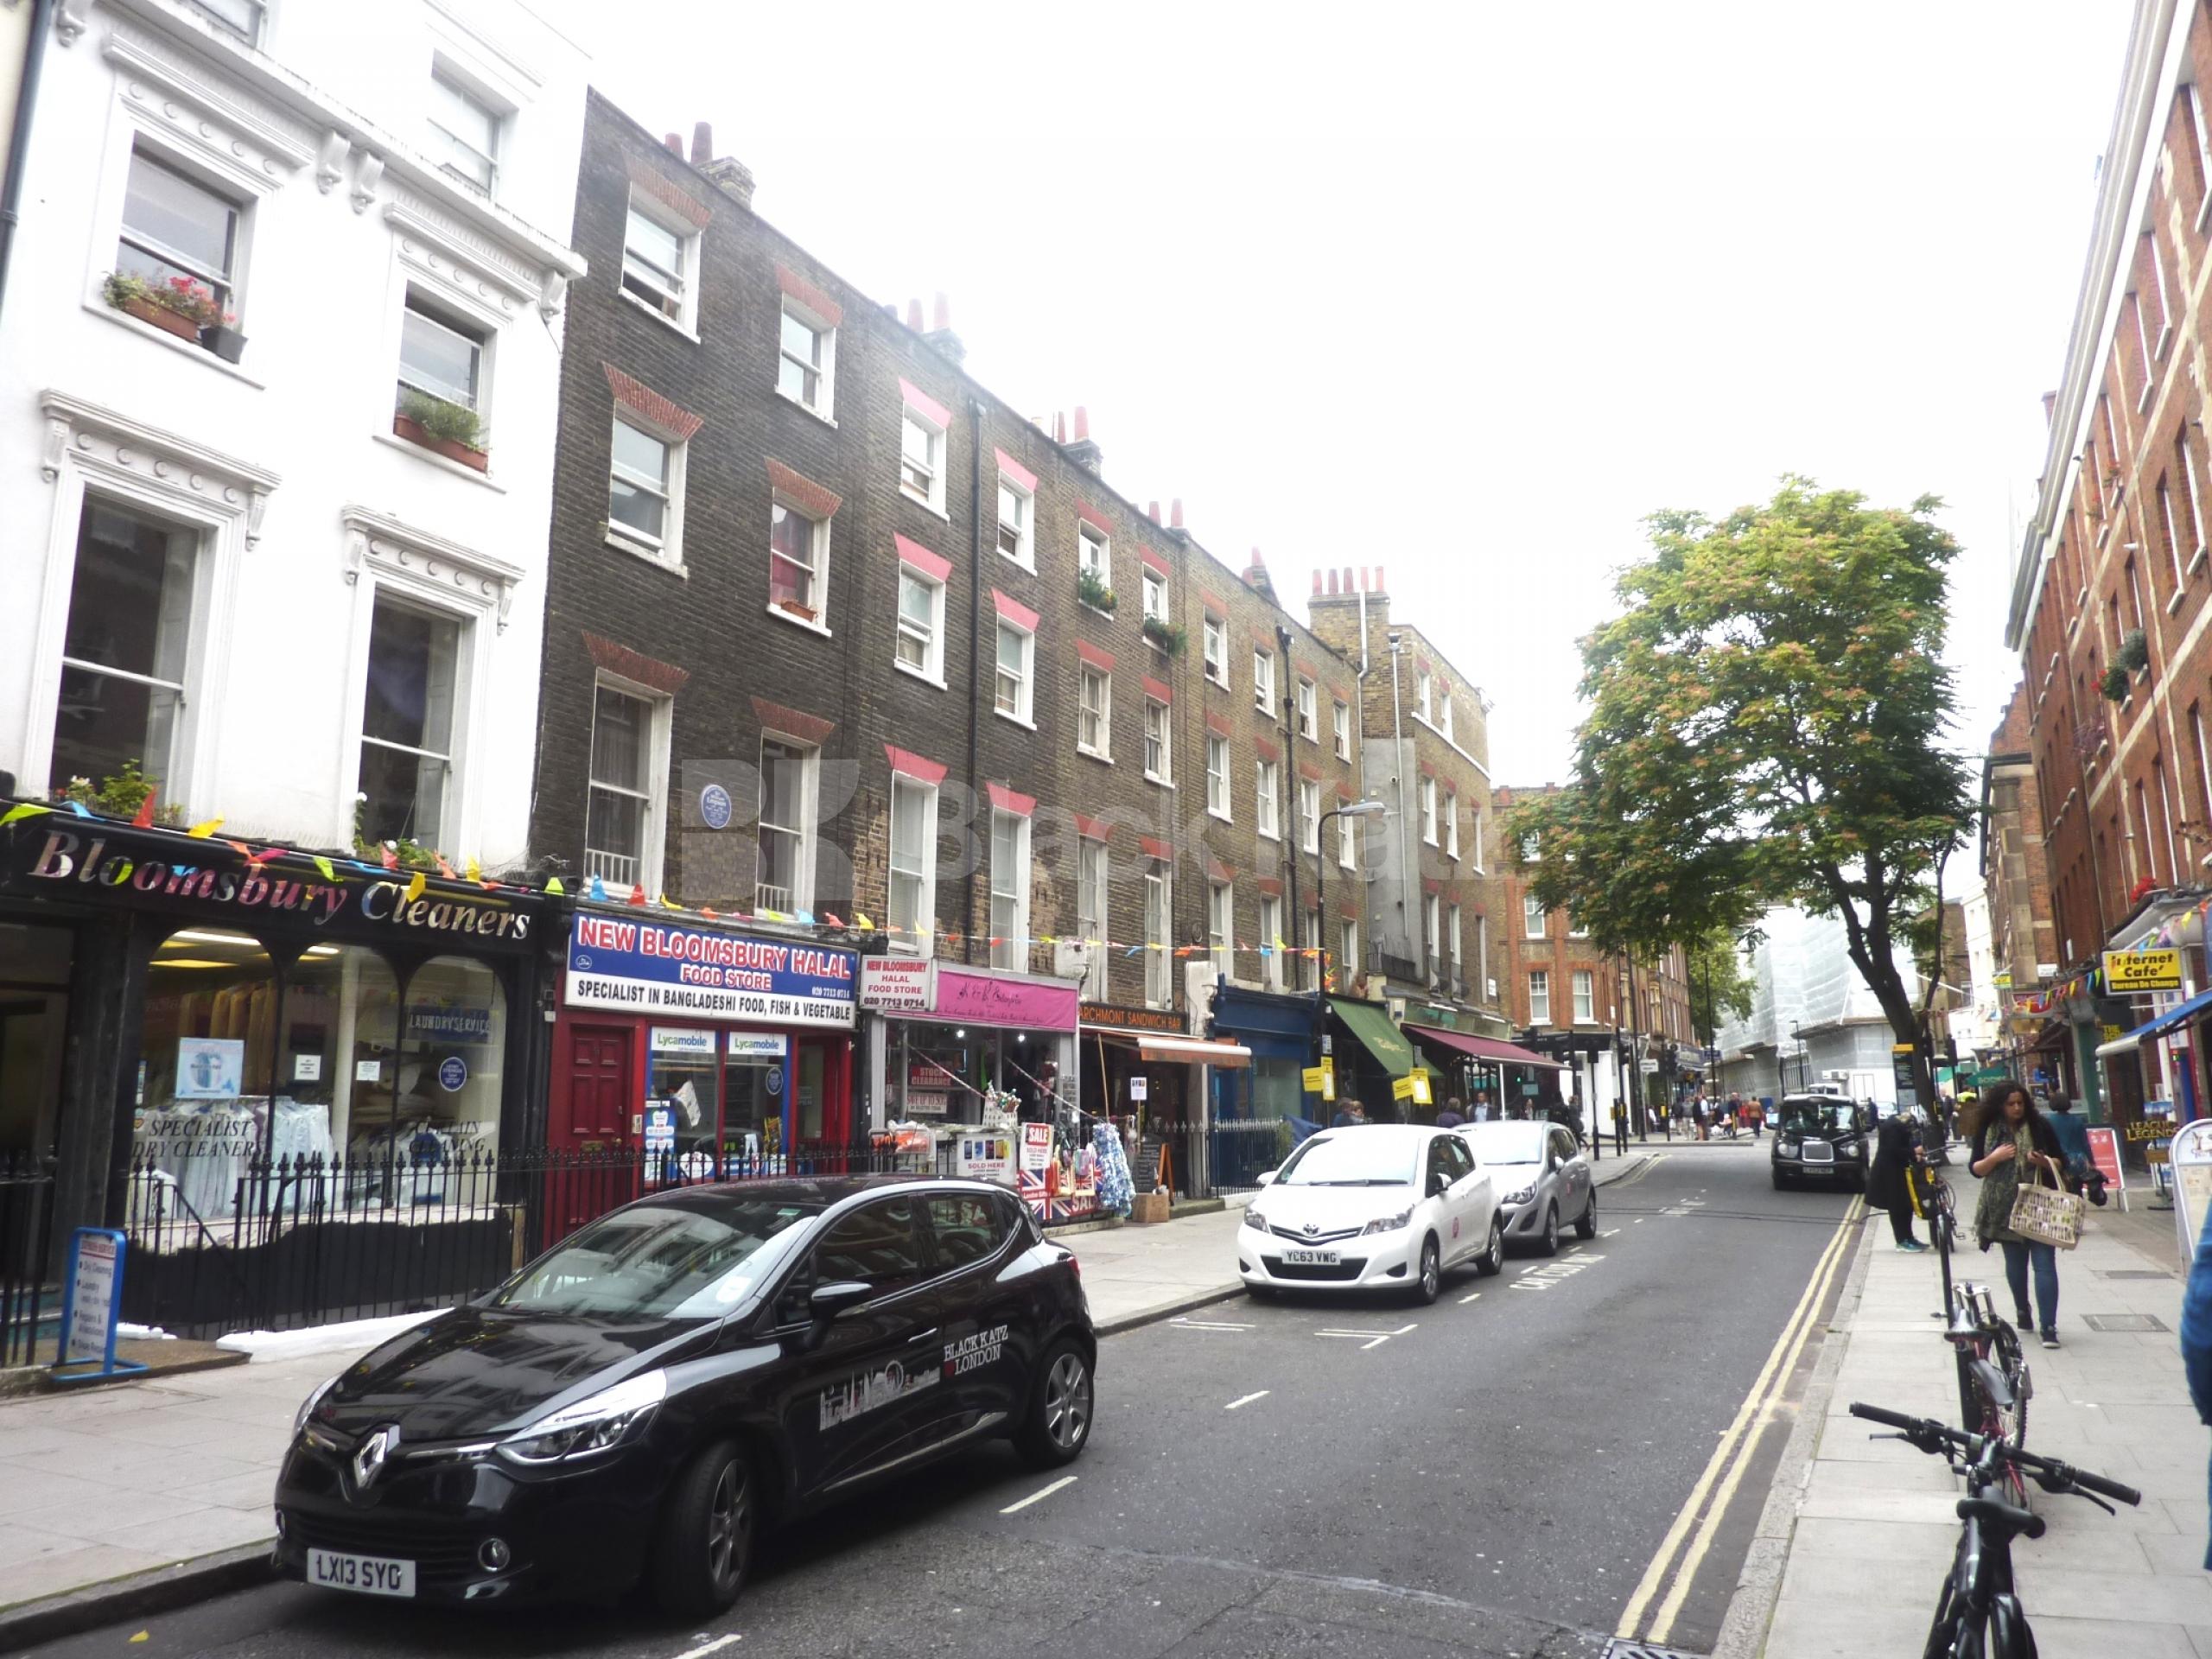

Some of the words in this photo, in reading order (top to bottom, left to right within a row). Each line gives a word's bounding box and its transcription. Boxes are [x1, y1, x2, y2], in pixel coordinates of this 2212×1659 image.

[28, 830, 347, 926] Bloomsbury
[361, 880, 531, 940] Cleaners
[578, 916, 636, 951] NEW
[640, 926, 789, 972] BLOOMSBURY
[791, 948, 851, 979] HALAL
[867, 961, 882, 971] NEW
[883, 961, 927, 973] BLOOMSBURY
[680, 963, 723, 986] FOOD
[725, 969, 772, 991] STORE
[893, 986, 923, 995] STORE
[578, 980, 645, 1002] SPECIALIST
[648, 987, 659, 1004] IN
[664, 989, 736, 1012] BANGLADESHI
[739, 996, 767, 1016] FOOD,
[770, 1000, 791, 1015] FISH
[794, 1003, 800, 1015] &
[803, 1004, 850, 1020] VEGETABLE
[864, 997, 880, 1006] 020
[881, 998, 902, 1007] 7713
[904, 999, 925, 1007] 0714
[1078, 1006, 1125, 1024] ARCHMONT
[1127, 1011, 1167, 1028] SANDWICH
[1167, 1015, 1182, 1030] BAR
[657, 1033, 708, 1046] Lycamobile
[734, 1038, 779, 1050] Lycamobile
[149, 1119, 252, 1137] SPECIALIST
[1028, 1127, 1049, 1142] SALE
[132, 1141, 171, 1158] DRY
[1072, 1192, 1097, 1211] SAL
[1287, 1251, 1313, 1262] YC63
[944, 1334, 979, 1363] BLACK
[979, 1324, 1008, 1349] KATZ
[954, 1344, 1002, 1376] LONDON
[316, 1554, 355, 1585] LX13
